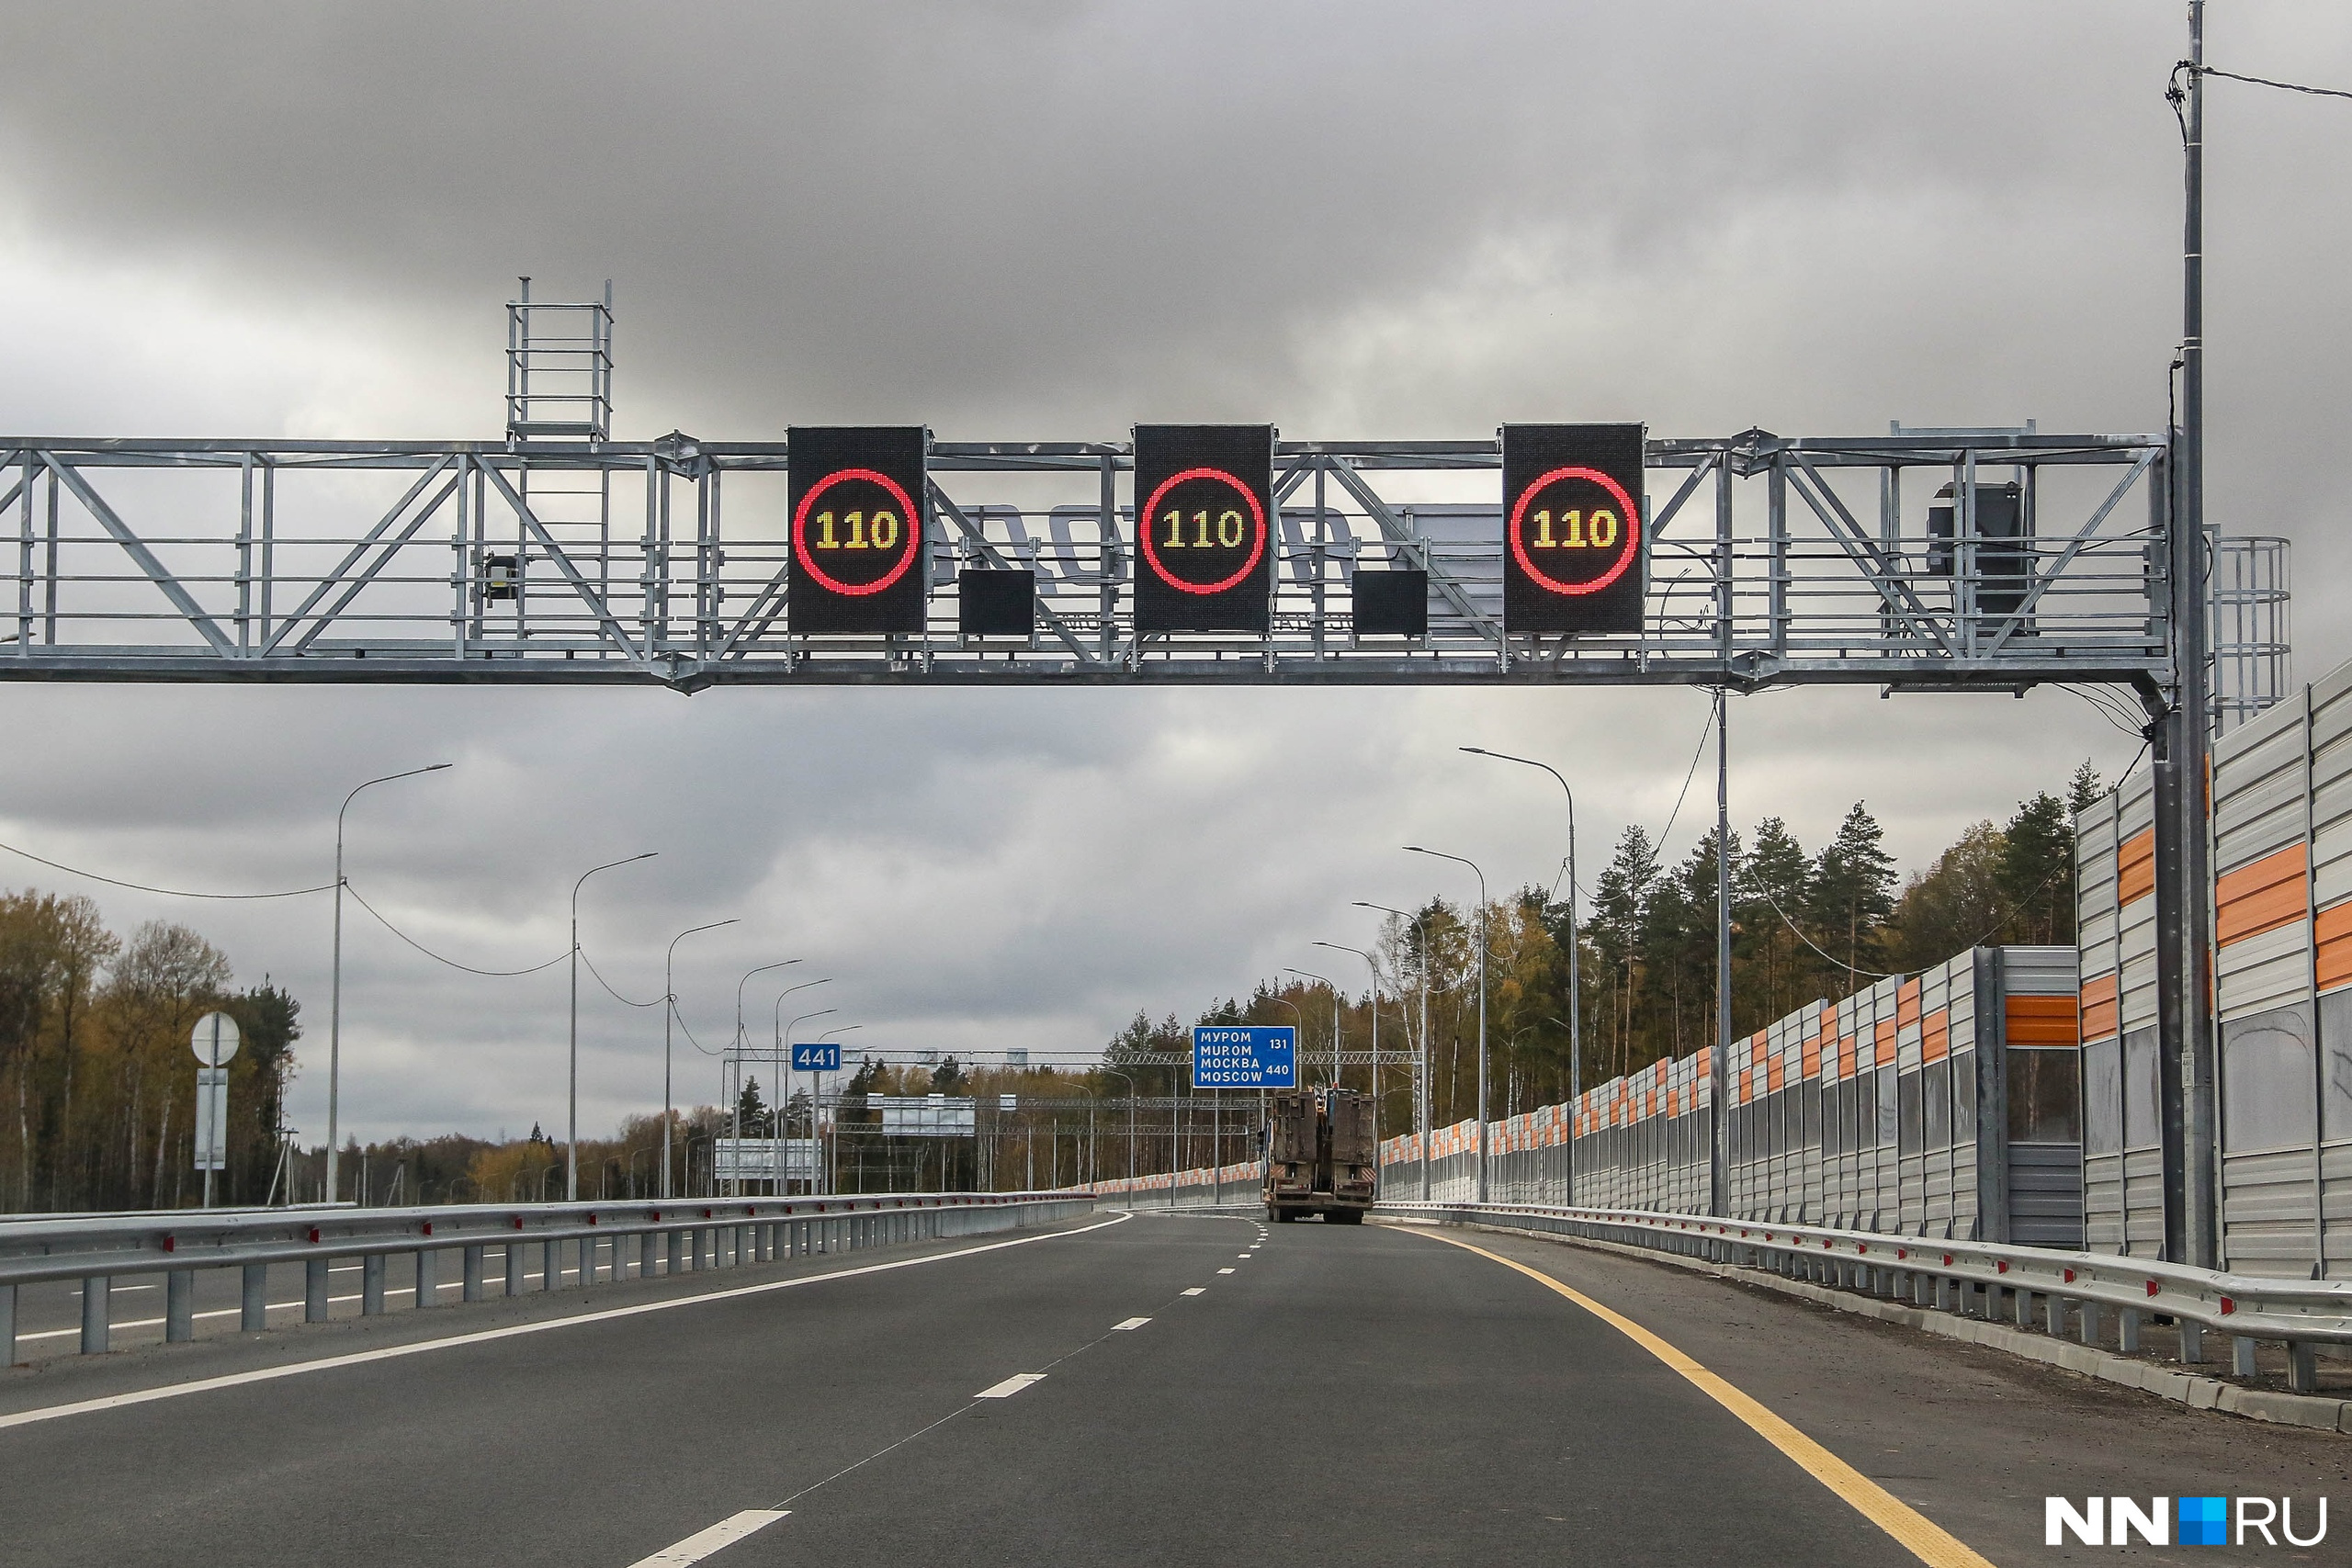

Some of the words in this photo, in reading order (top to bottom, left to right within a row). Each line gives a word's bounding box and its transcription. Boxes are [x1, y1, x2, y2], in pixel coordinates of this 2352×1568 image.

[815, 511, 899, 549] 110
[1162, 510, 1244, 548] 110
[1532, 509, 1618, 548] 110
[1200, 1032, 1251, 1043] МУРОМ
[1269, 1039, 1287, 1049] 131
[1200, 1045, 1251, 1056] MUROM
[797, 1048, 835, 1066] 441
[1200, 1057, 1261, 1068] МОСКВА
[1265, 1065, 1289, 1076] 440
[1200, 1071, 1262, 1082] MOSCOW
